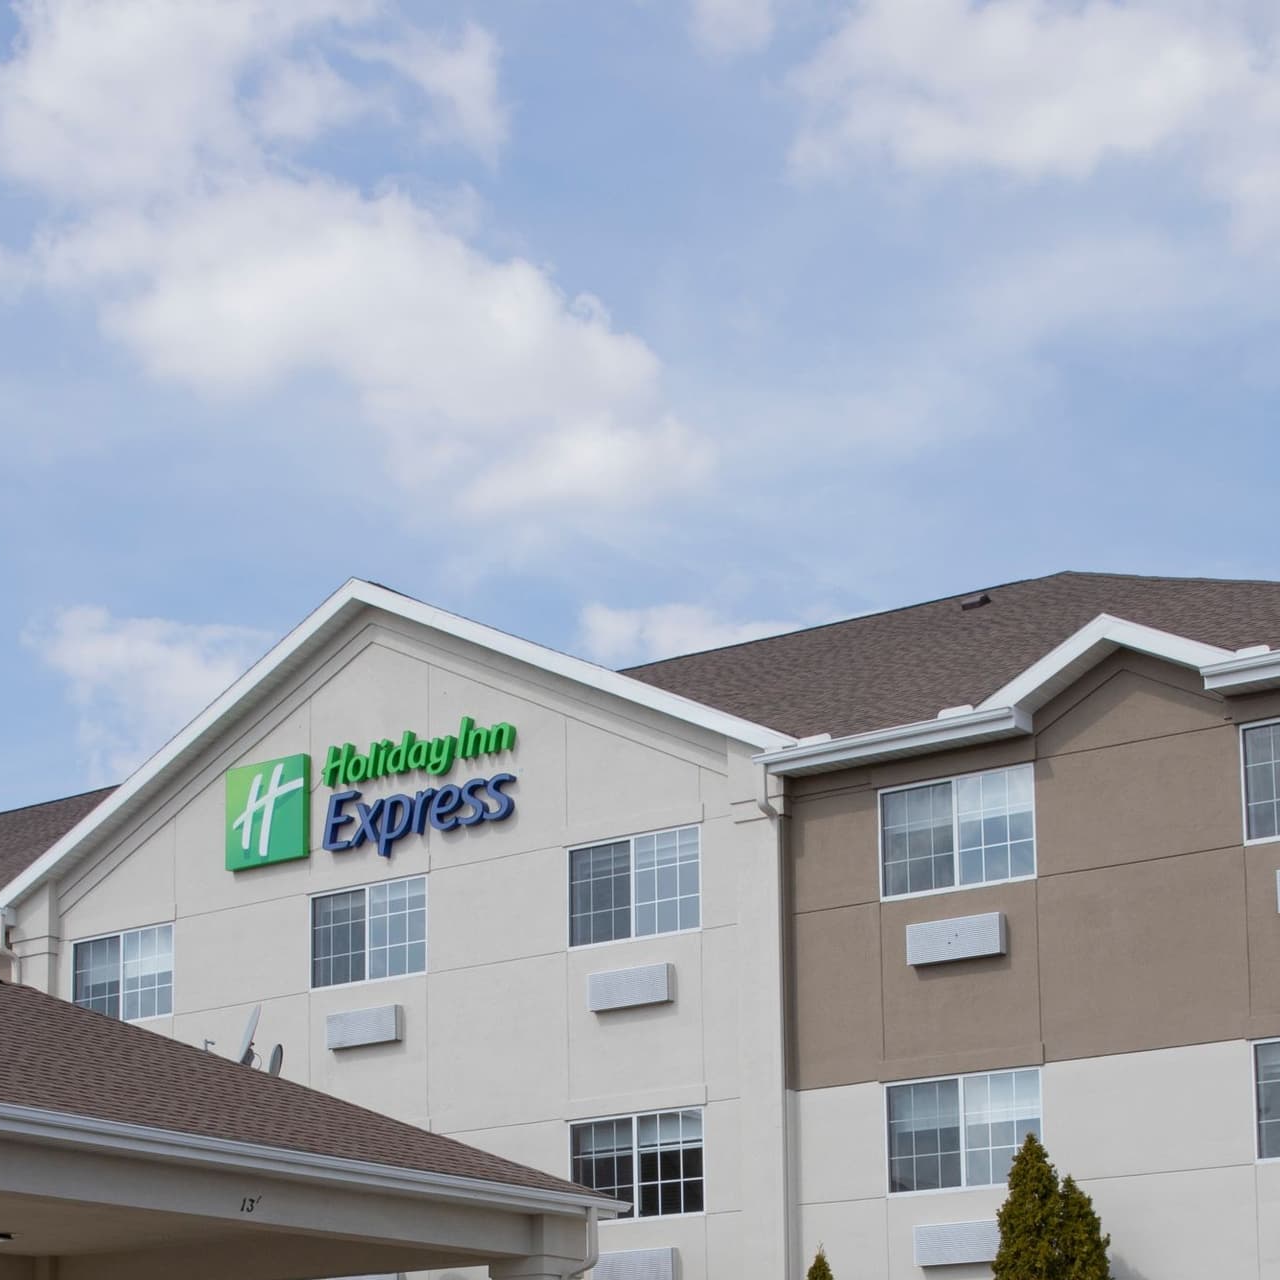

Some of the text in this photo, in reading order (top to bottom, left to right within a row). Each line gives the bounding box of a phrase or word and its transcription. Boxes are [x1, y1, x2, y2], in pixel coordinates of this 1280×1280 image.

[322, 716, 517, 787] Holiday Inn
[322, 773, 516, 858] Express
